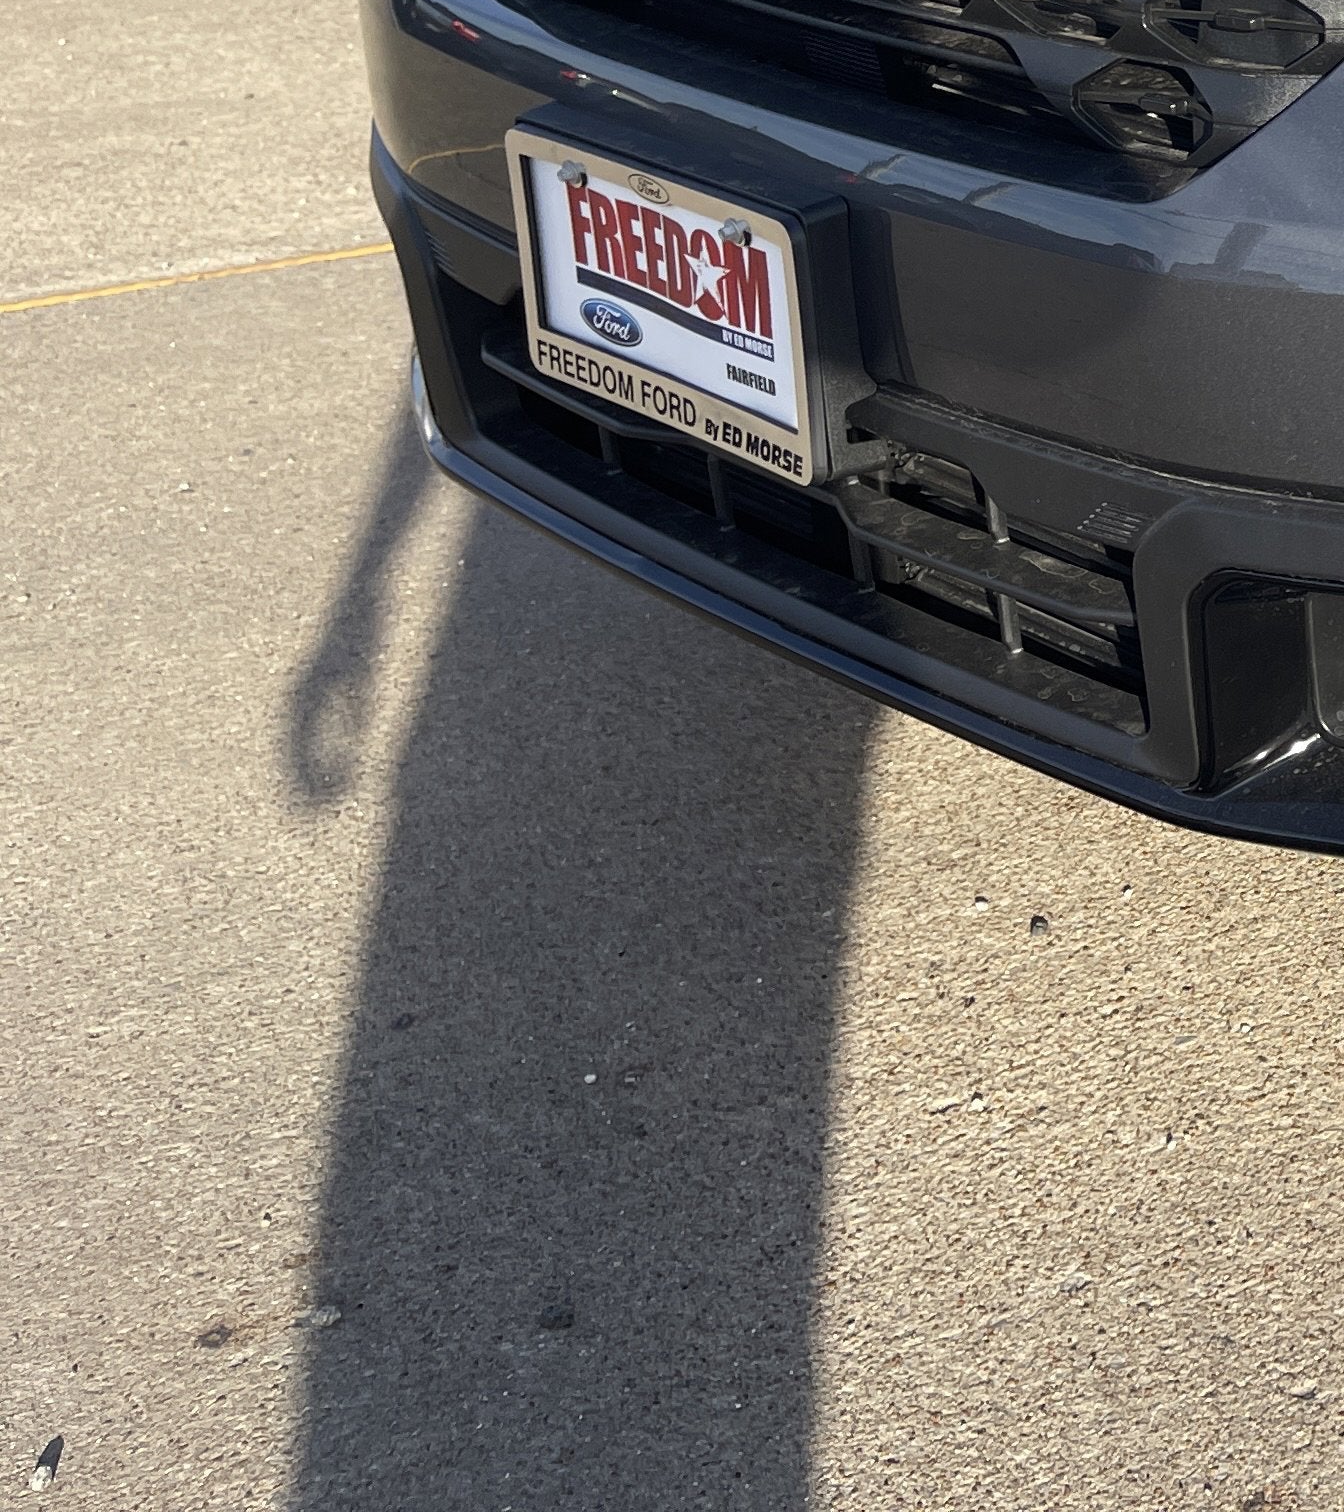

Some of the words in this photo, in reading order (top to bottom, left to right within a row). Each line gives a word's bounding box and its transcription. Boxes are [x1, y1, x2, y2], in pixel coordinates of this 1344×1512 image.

[637, 175, 662, 200] Ford
[564, 180, 774, 341] FREEDOM
[592, 305, 632, 341] Ford
[721, 329, 733, 345] BY
[734, 333, 745, 349] ED
[745, 338, 773, 359] MORSE
[726, 362, 777, 397] FAIRFIELD
[536, 339, 635, 404] FREEDOM
[640, 379, 697, 428] FORD
[722, 421, 743, 449] ED
[745, 431, 804, 479] MORSE
